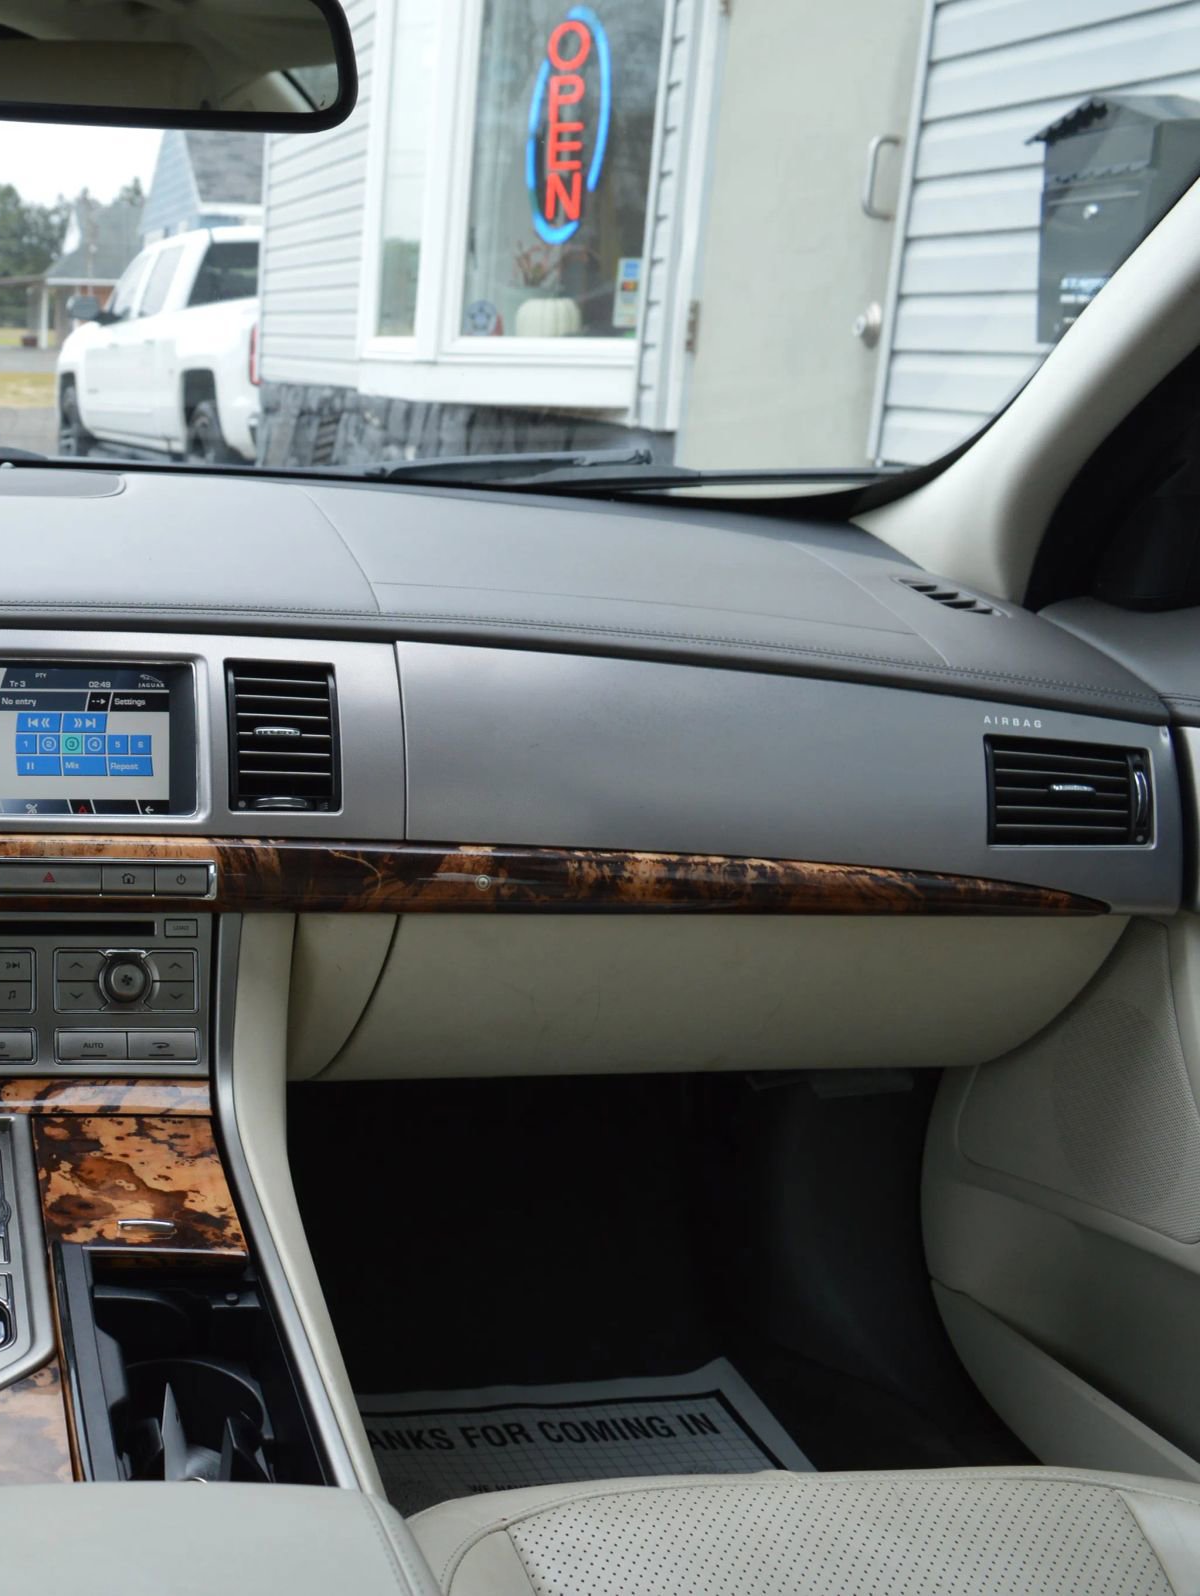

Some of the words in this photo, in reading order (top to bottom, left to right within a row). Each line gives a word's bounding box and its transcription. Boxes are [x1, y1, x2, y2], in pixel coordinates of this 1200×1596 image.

[544, 20, 591, 221] OPEN
[1, 697, 14, 705] No
[15, 698, 37, 706] entry
[114, 698, 146, 707] Settings
[983, 715, 1042, 728] AIRBAG
[367, 1428, 455, 1450] ANKS
[459, 1423, 534, 1449] FOR
[538, 1416, 676, 1443] COMING
[677, 1413, 720, 1436] IN
